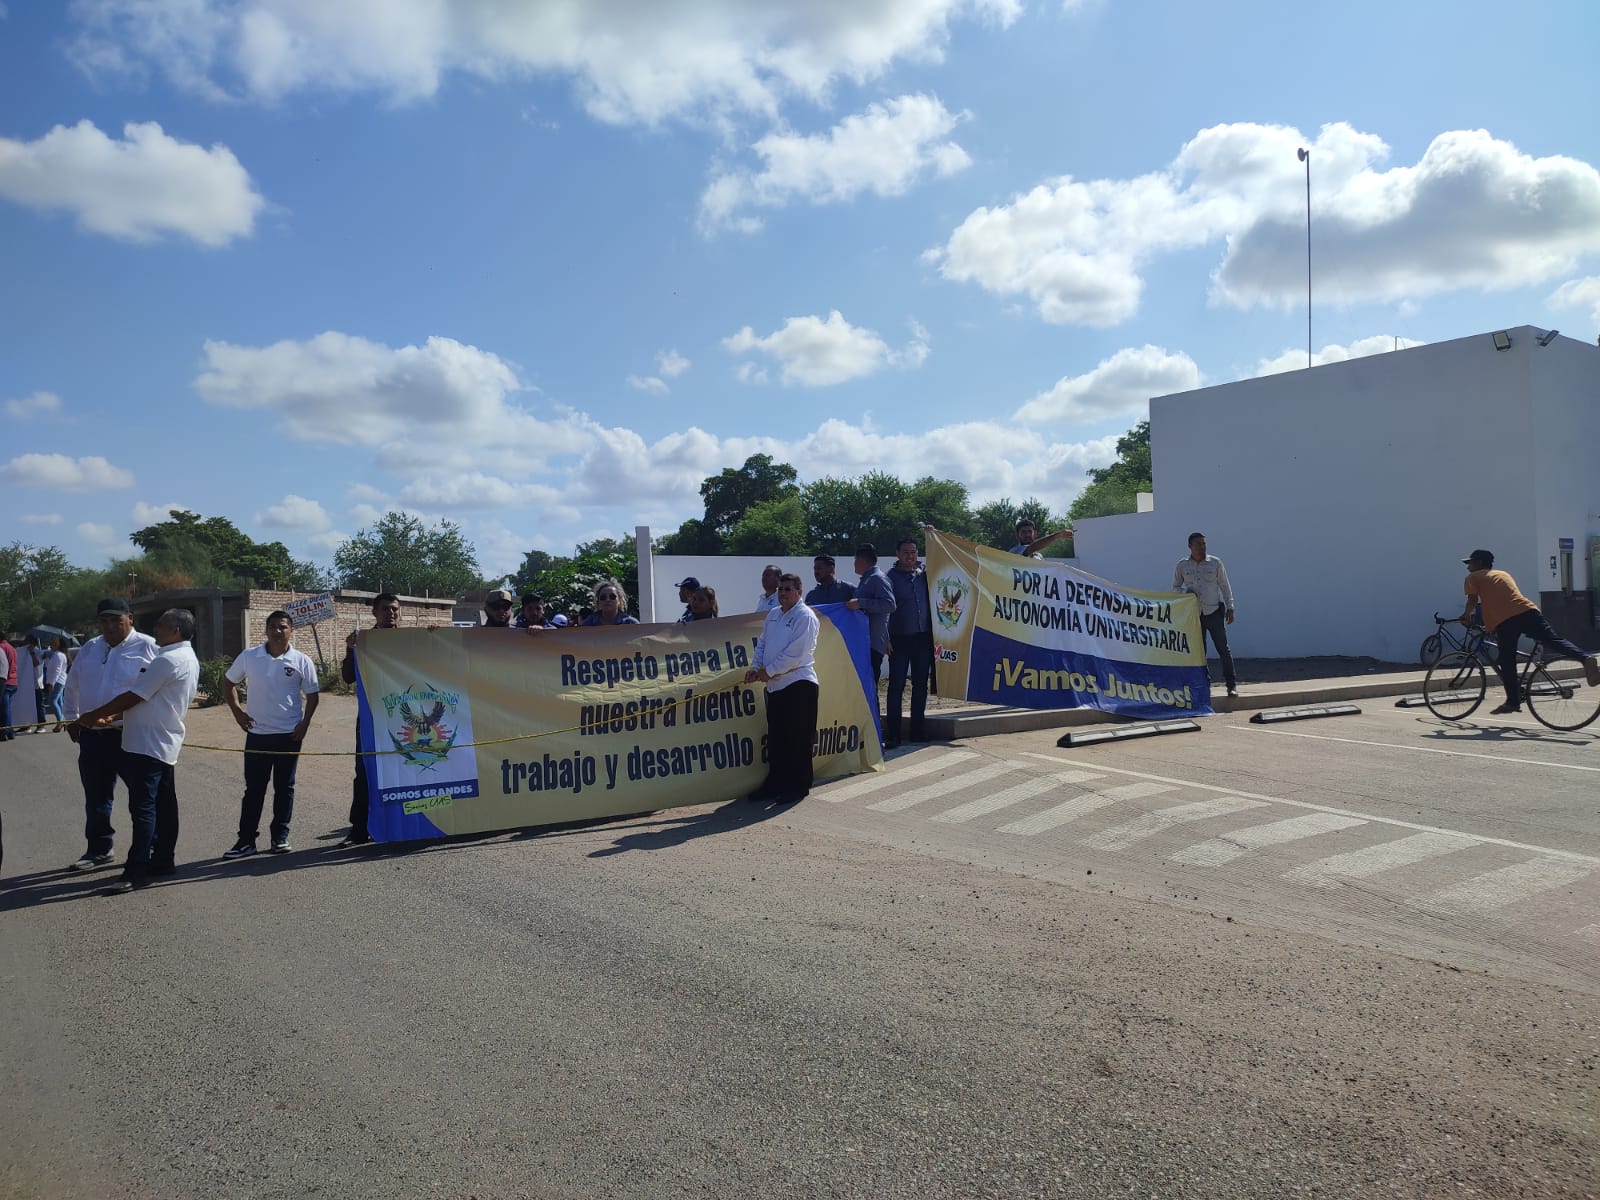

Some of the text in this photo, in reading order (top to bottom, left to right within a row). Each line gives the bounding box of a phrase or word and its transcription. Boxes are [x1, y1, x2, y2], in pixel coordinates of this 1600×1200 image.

[1012, 568, 1172, 624] POR LA DEFENSA DE LA
[993, 596, 1191, 654] AUTONOMÍA UNIVERSITARIA
[561, 652, 659, 688] Respeto
[665, 648, 721, 682] para
[725, 641, 748, 669] la
[940, 651, 957, 661] UAS
[992, 658, 1192, 709] ¡Vamos Juntos!
[580, 695, 677, 736] nuestra
[684, 685, 756, 724] fuente
[501, 750, 597, 794] trabajo
[605, 752, 618, 790] y
[627, 732, 754, 781] desarrollo
[382, 785, 473, 802] SOMOS GRANDES
